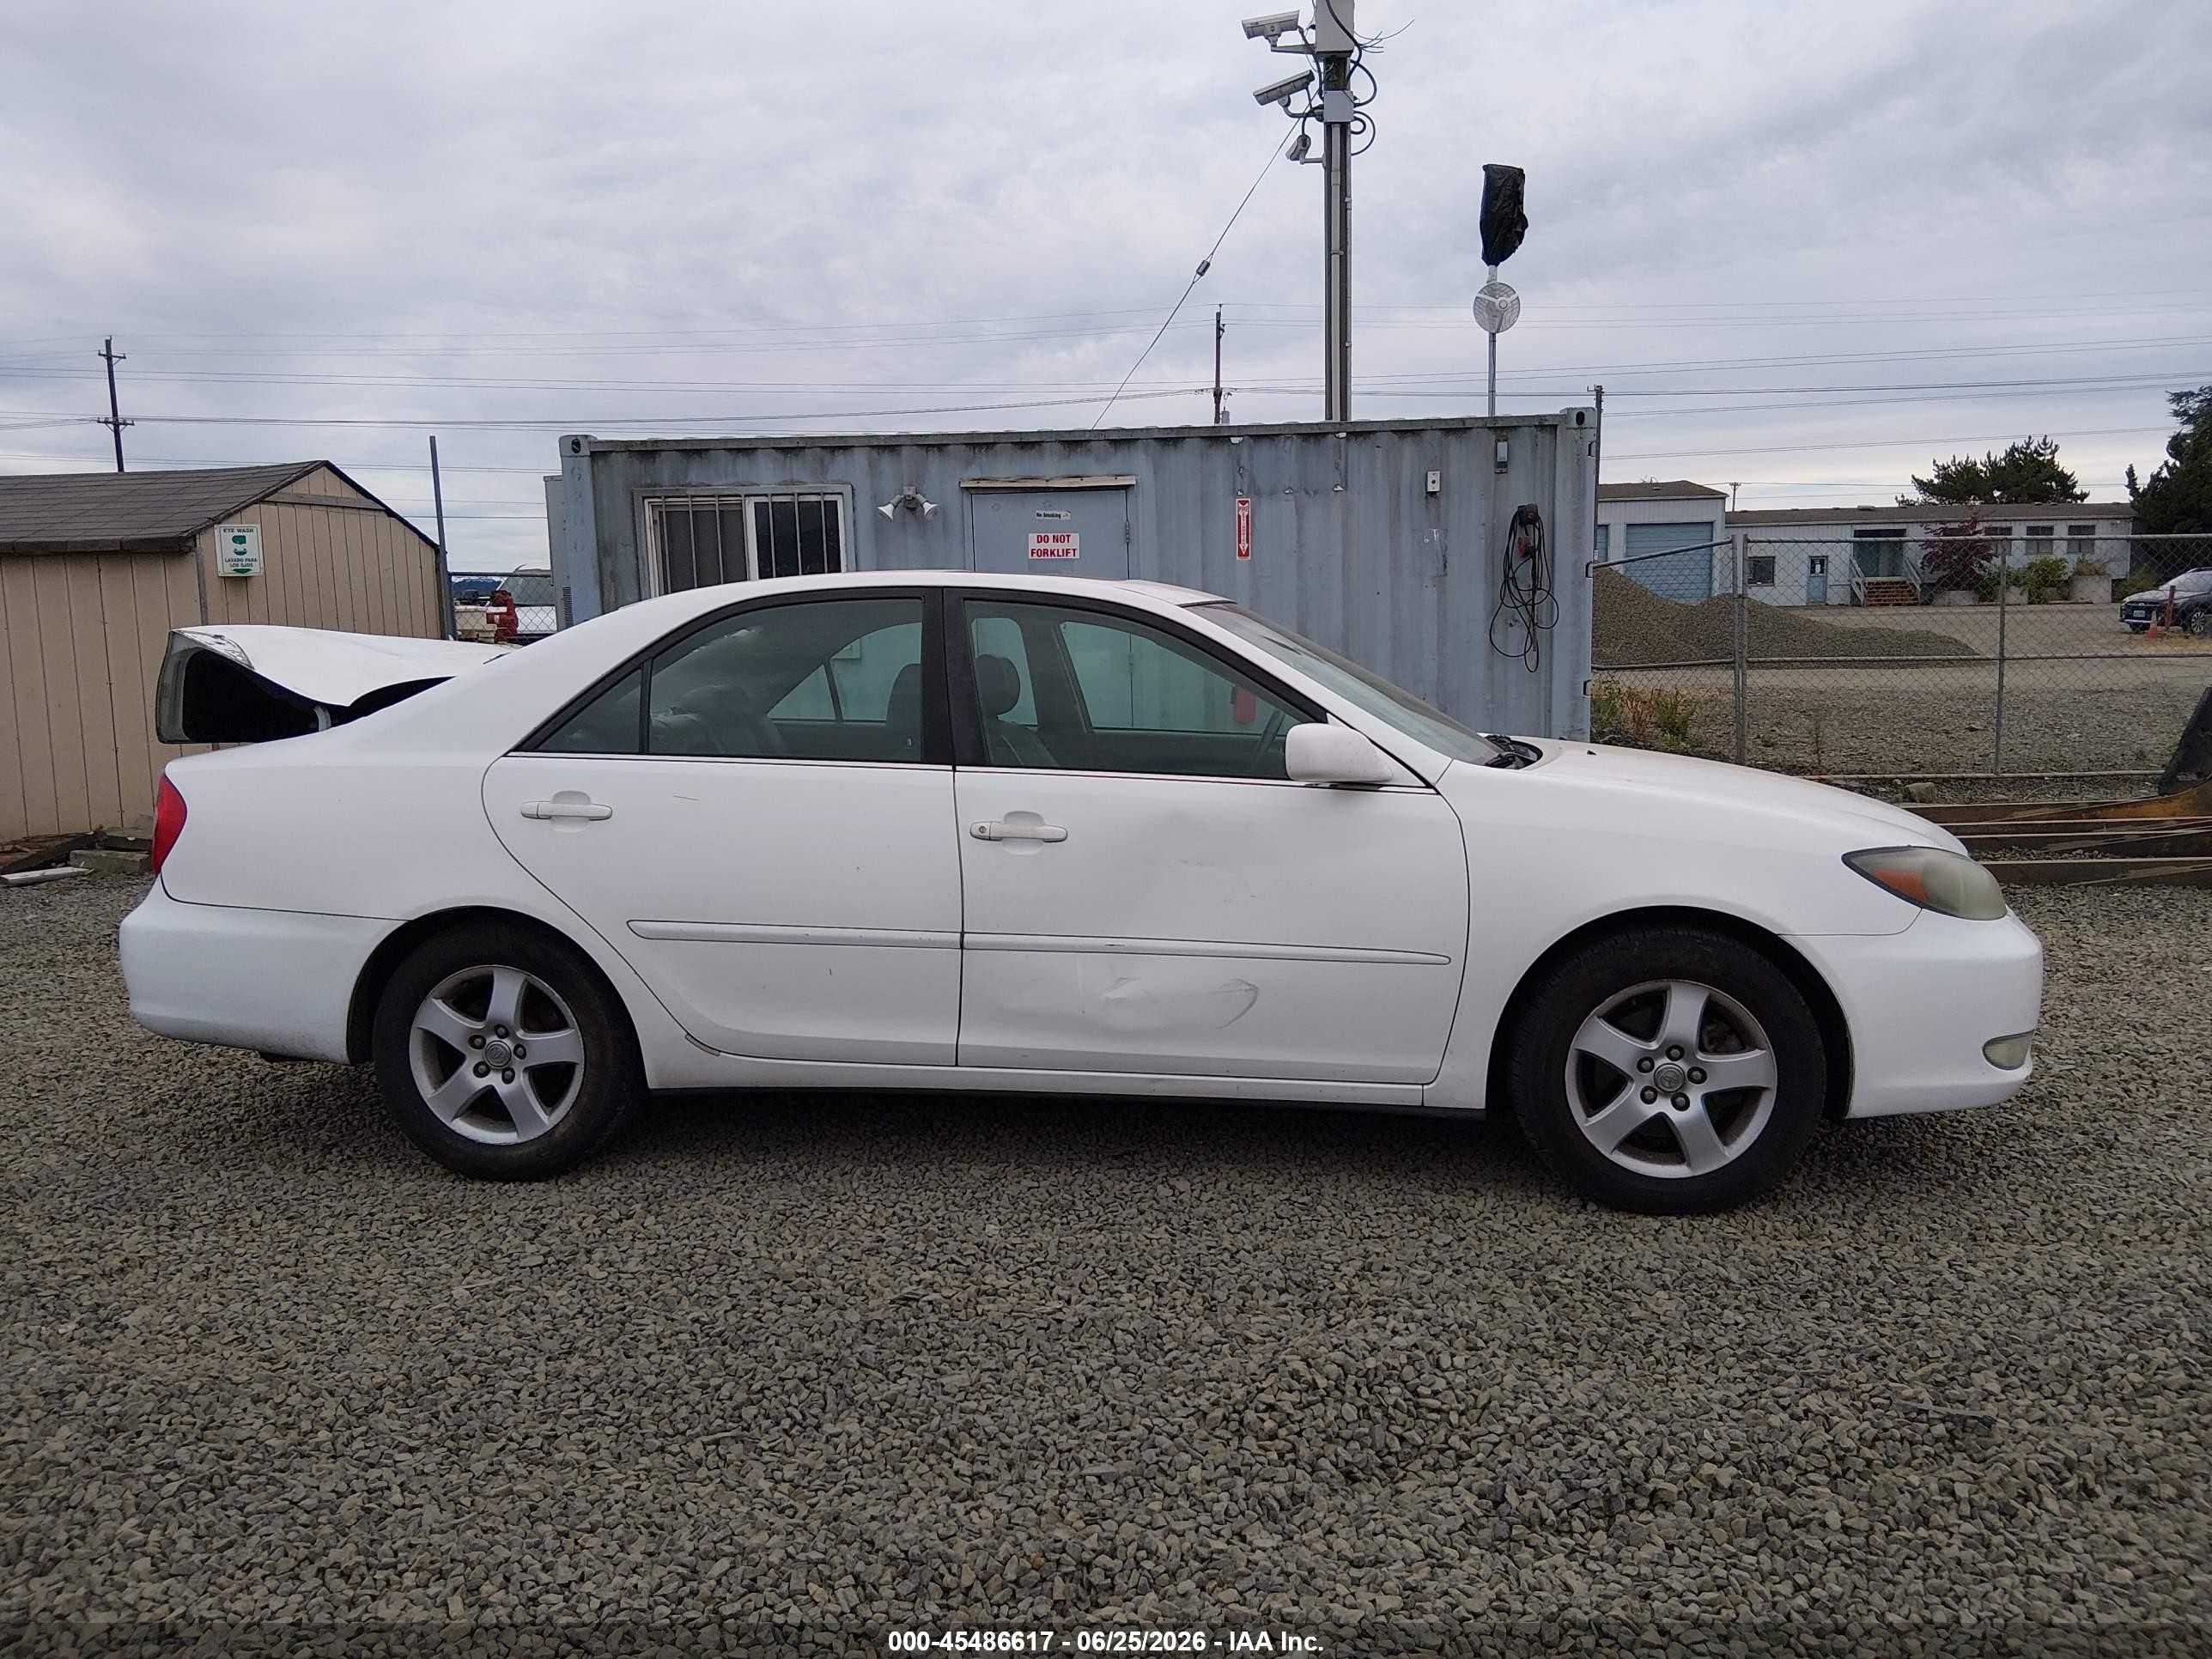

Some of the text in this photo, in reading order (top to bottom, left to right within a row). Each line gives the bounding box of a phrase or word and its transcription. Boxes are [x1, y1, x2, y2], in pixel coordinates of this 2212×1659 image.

[1036, 534, 1072, 544] DO NOT
[1030, 548, 1077, 557] FORKLIFT
